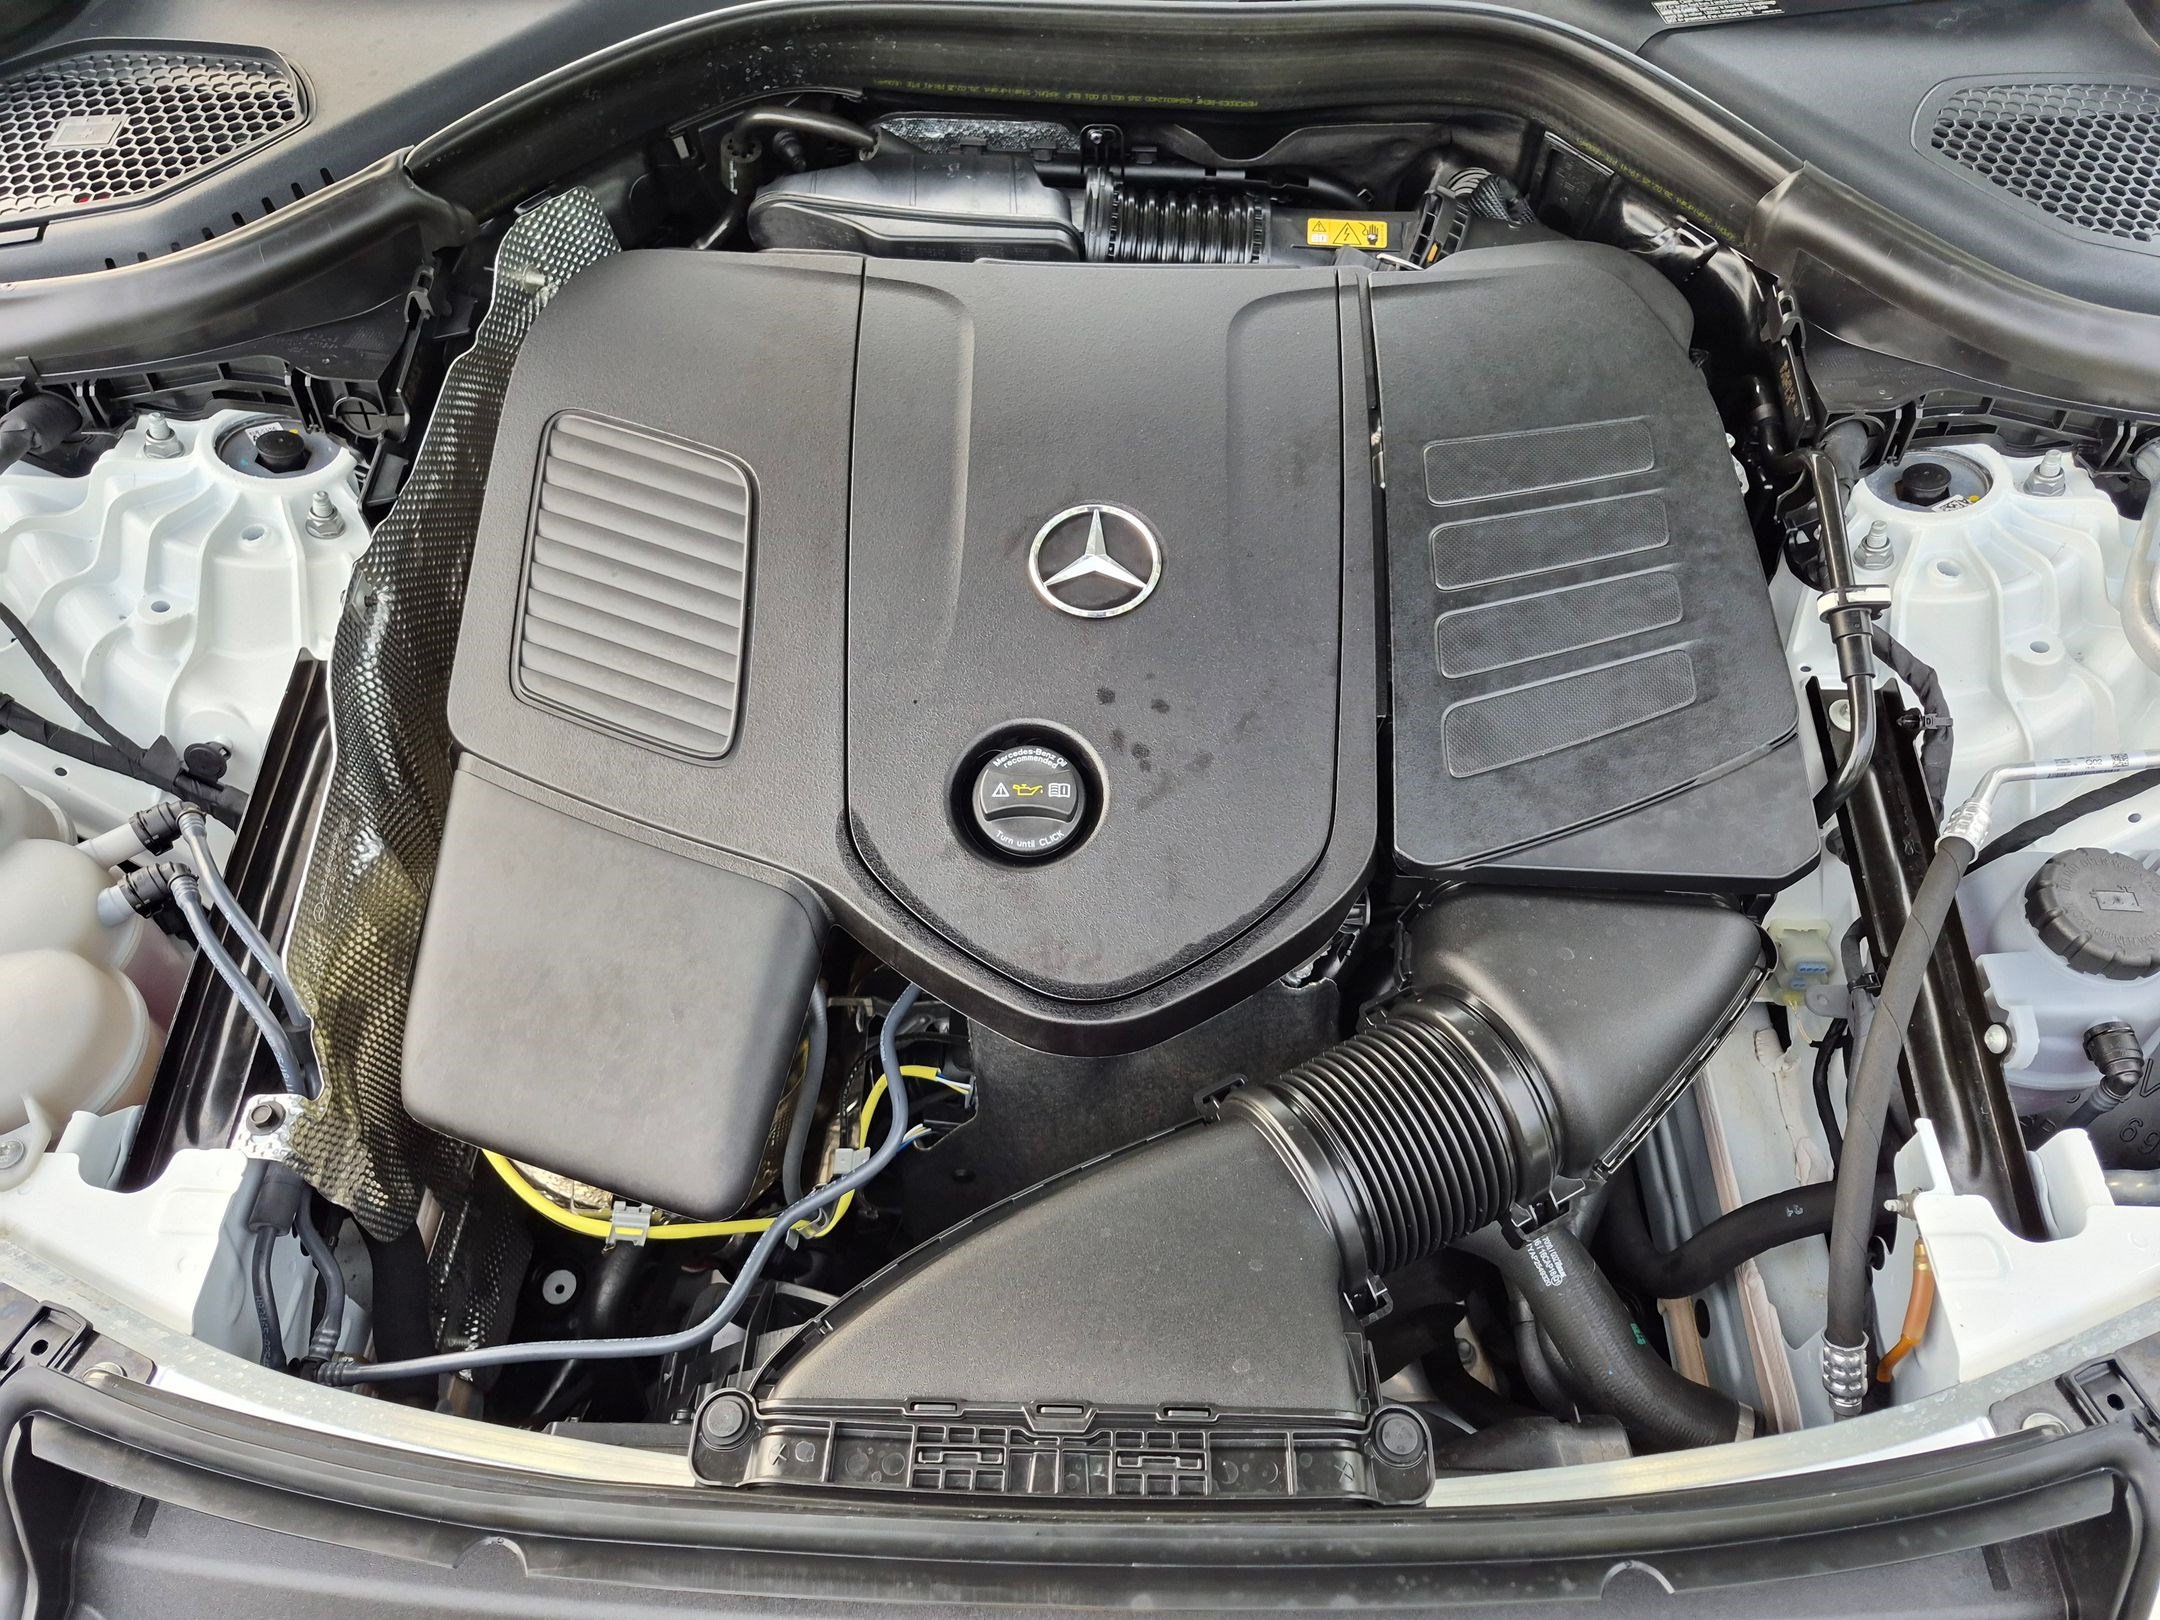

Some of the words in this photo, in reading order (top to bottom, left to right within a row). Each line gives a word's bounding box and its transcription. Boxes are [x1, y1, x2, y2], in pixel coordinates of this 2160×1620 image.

[993, 748, 1056, 767] Mercedes-Benz
[1057, 756, 1068, 768] Oil
[1003, 755, 1058, 769] recommended
[996, 830, 1014, 845] Turn
[1017, 840, 1036, 848] until
[1039, 830, 1065, 846] CLICK
